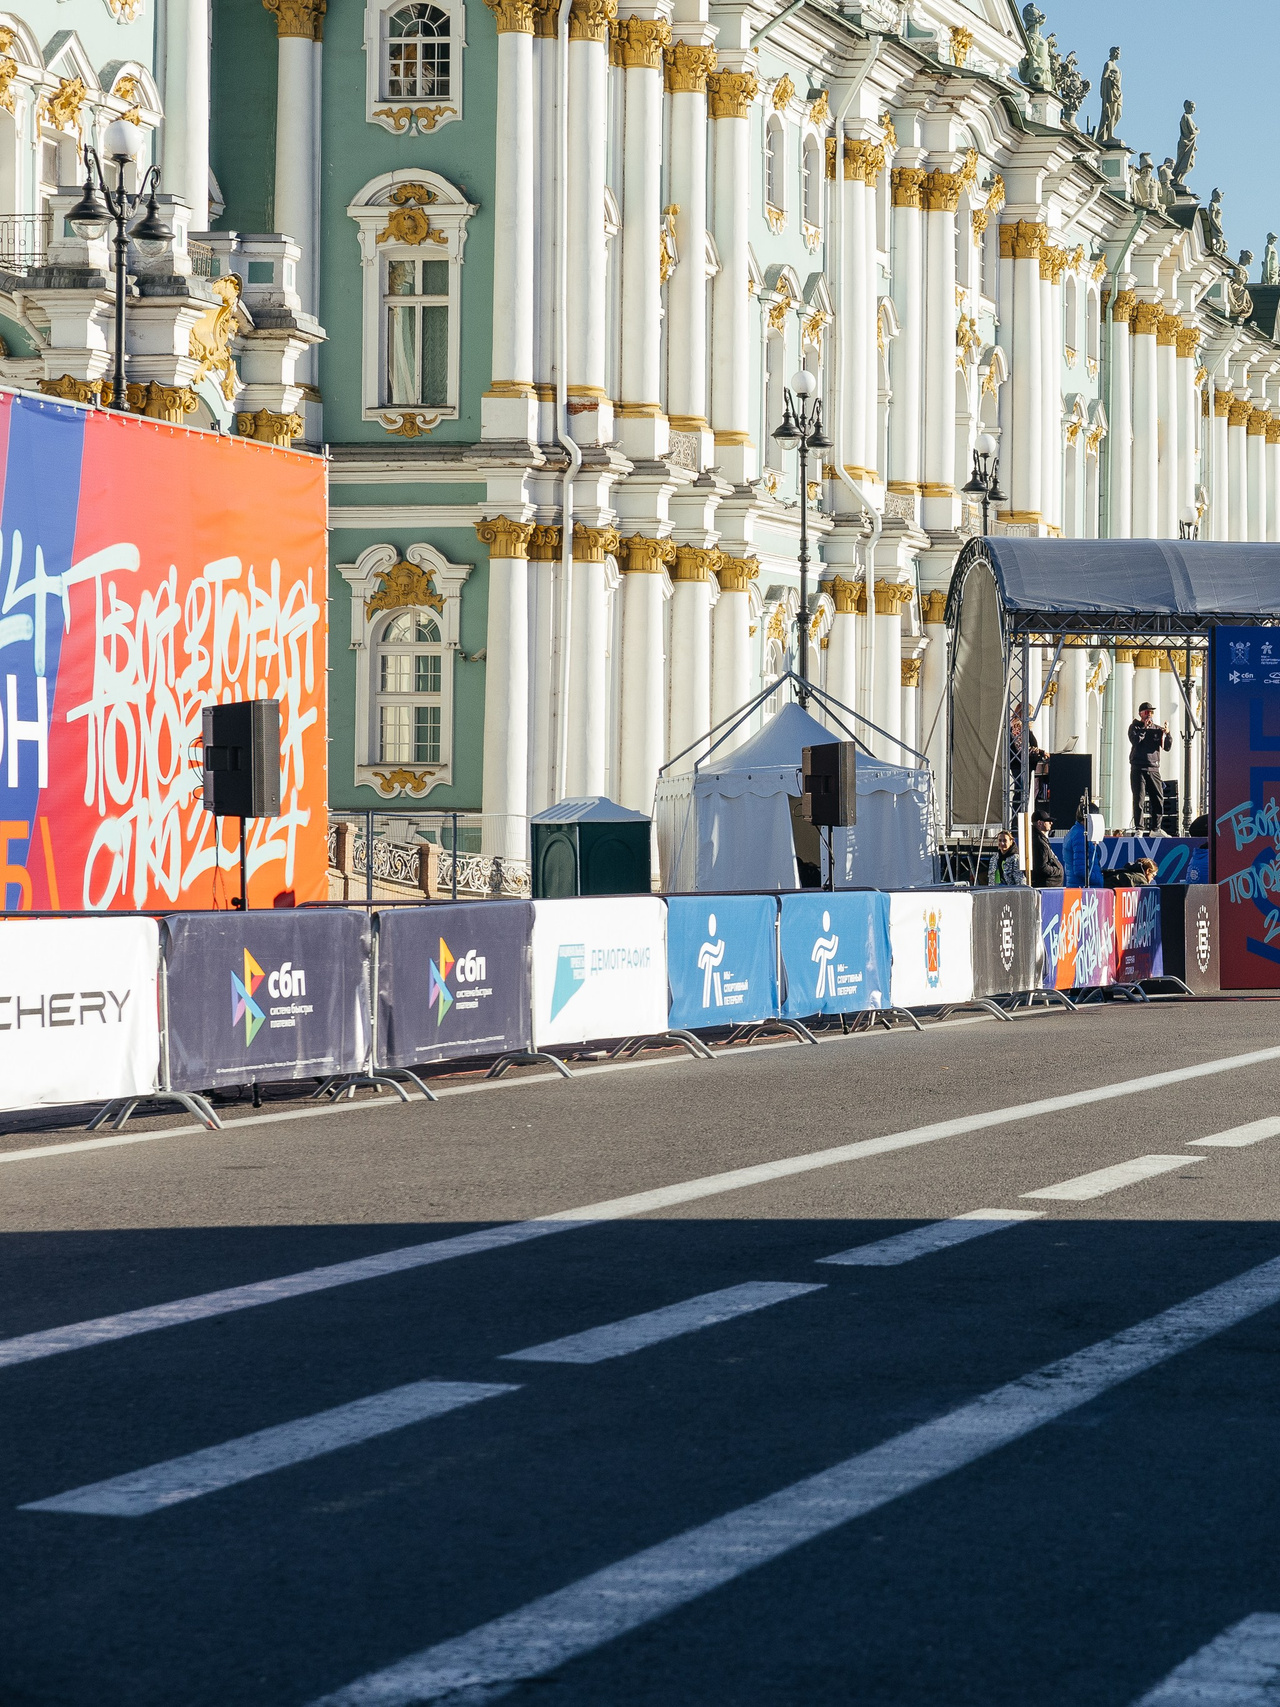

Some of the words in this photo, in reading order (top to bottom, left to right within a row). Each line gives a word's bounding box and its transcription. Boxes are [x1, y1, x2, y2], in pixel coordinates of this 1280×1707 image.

[455, 949, 486, 983] сбп
[590, 946, 651, 977] ДЕМОГРАФИЯ
[267, 961, 306, 999] сбп
